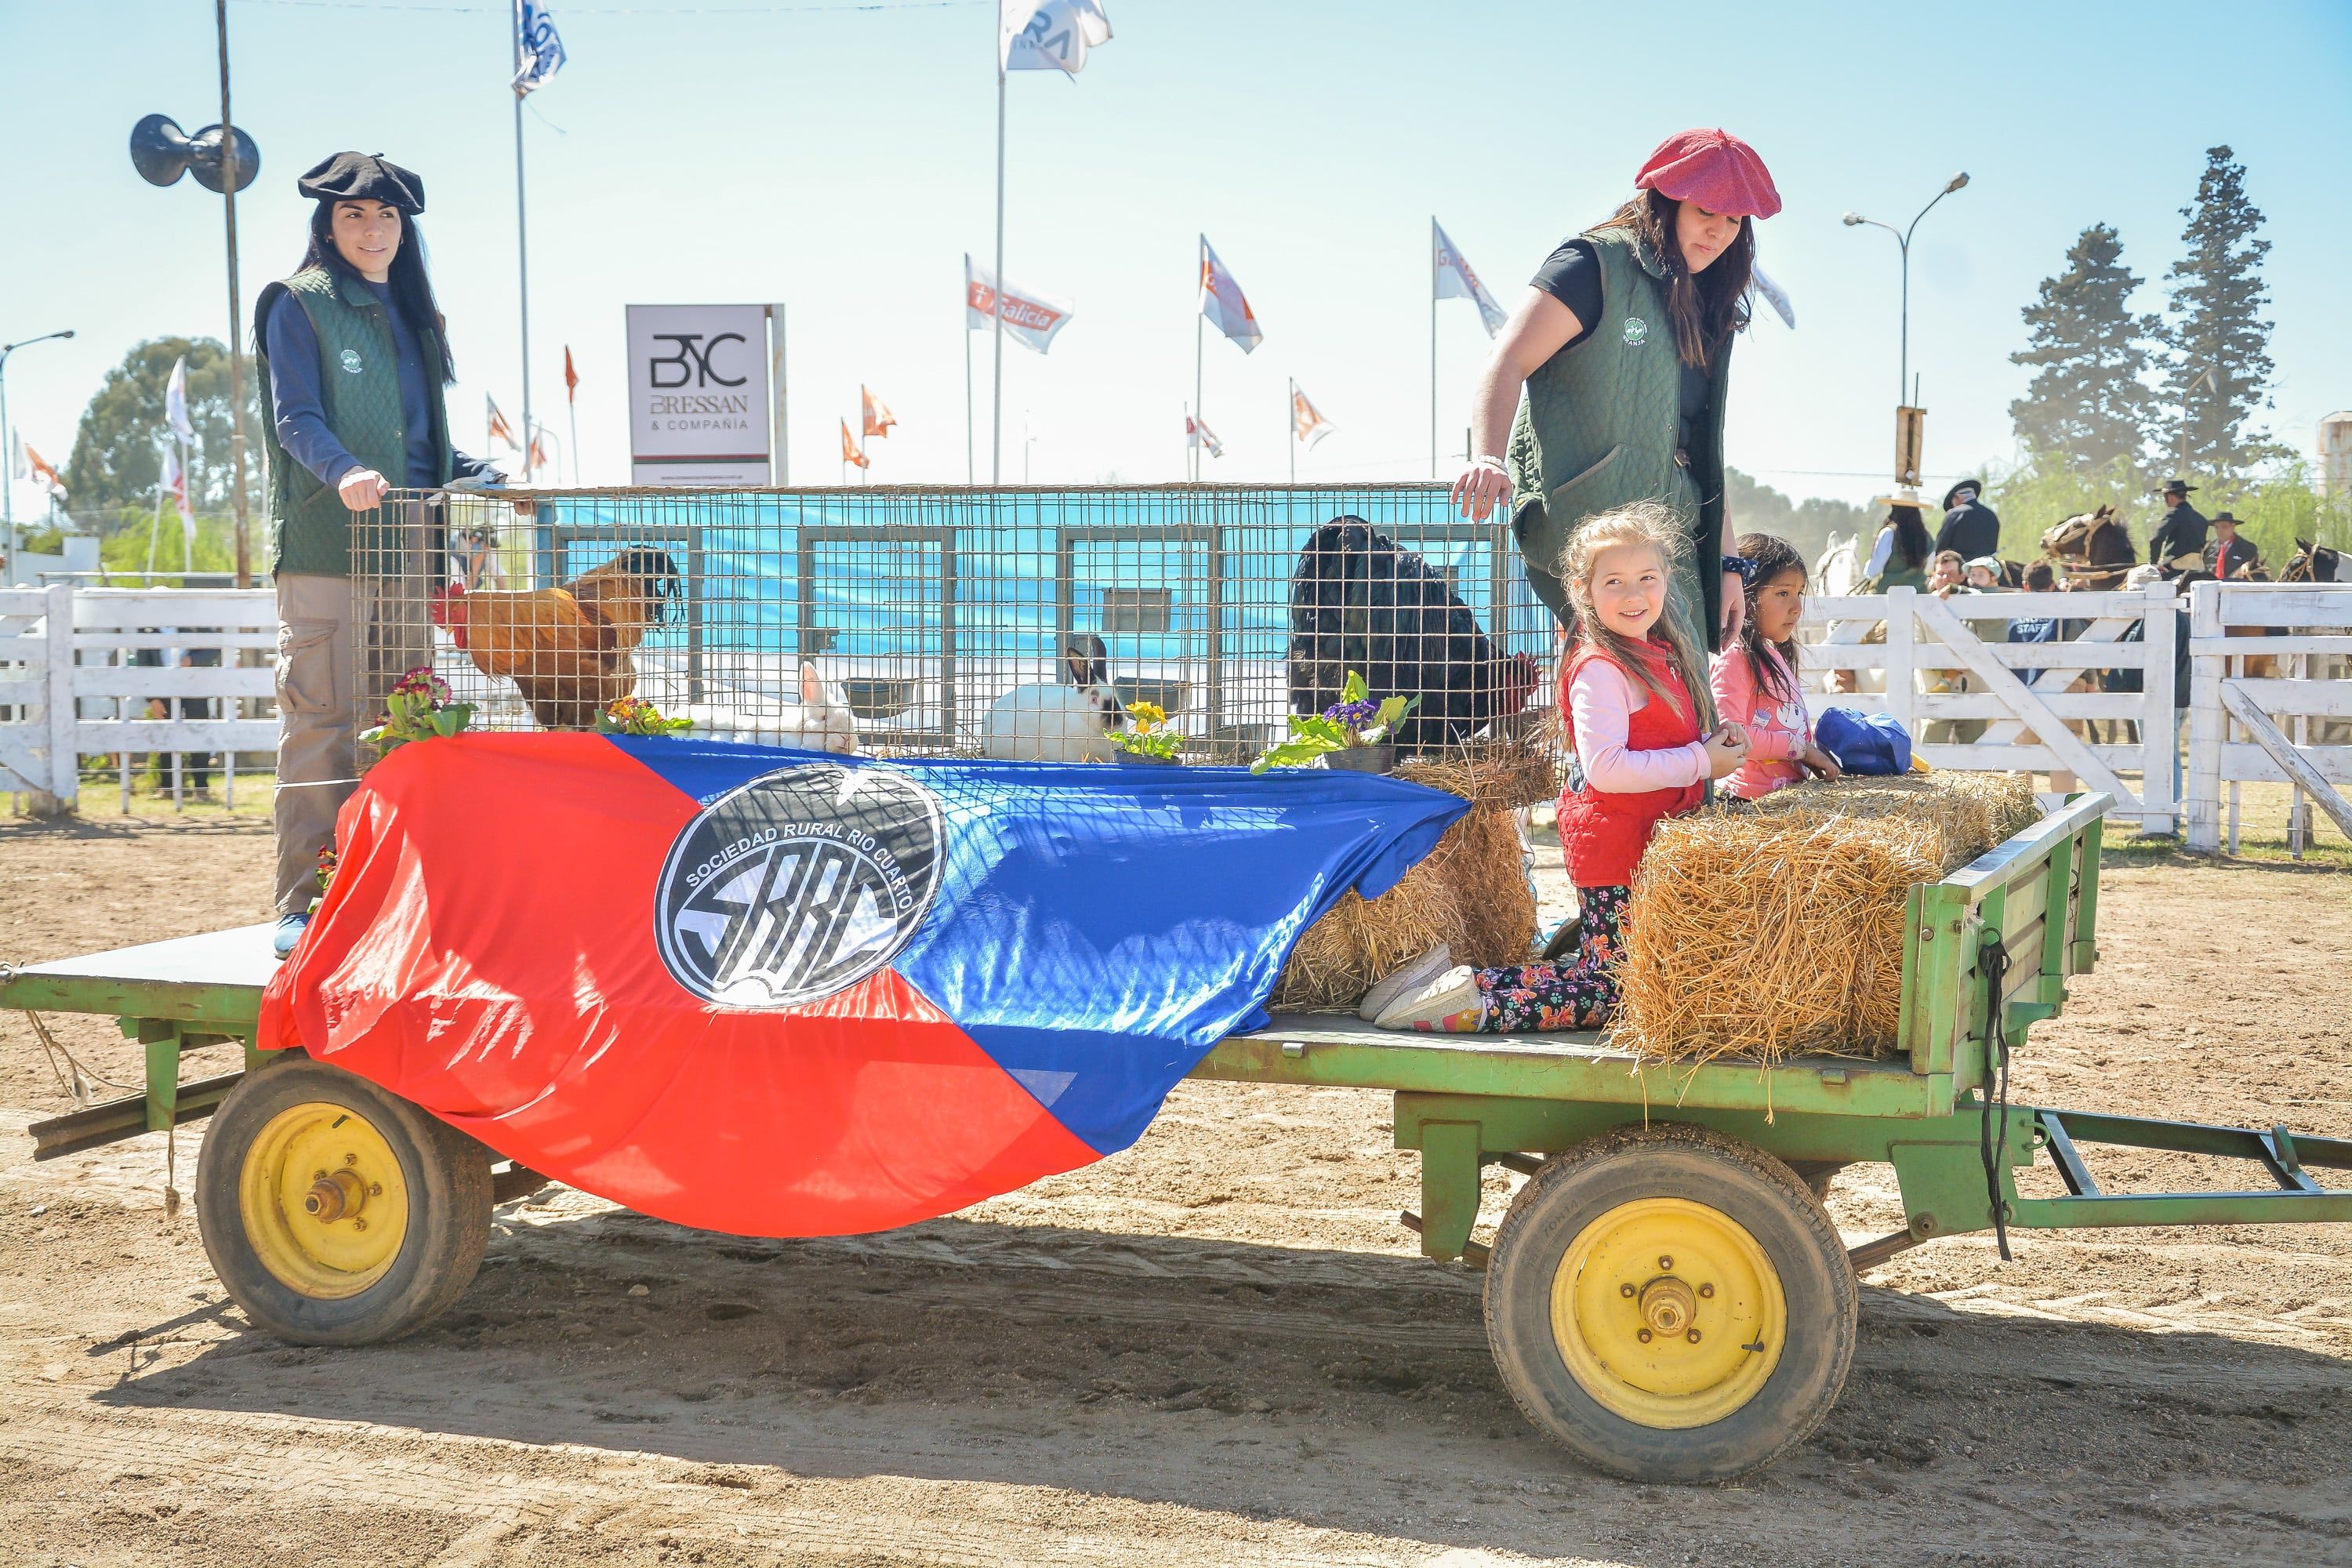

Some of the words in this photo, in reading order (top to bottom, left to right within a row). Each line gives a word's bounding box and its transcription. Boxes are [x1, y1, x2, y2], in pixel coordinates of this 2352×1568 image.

[649, 394, 749, 414] BRESSAN
[651, 419, 660, 430] &
[685, 826, 778, 888] SOCIEDAD
[784, 822, 844, 839] RURAL
[846, 828, 876, 853] RIO
[873, 848, 913, 910] CUARTO
